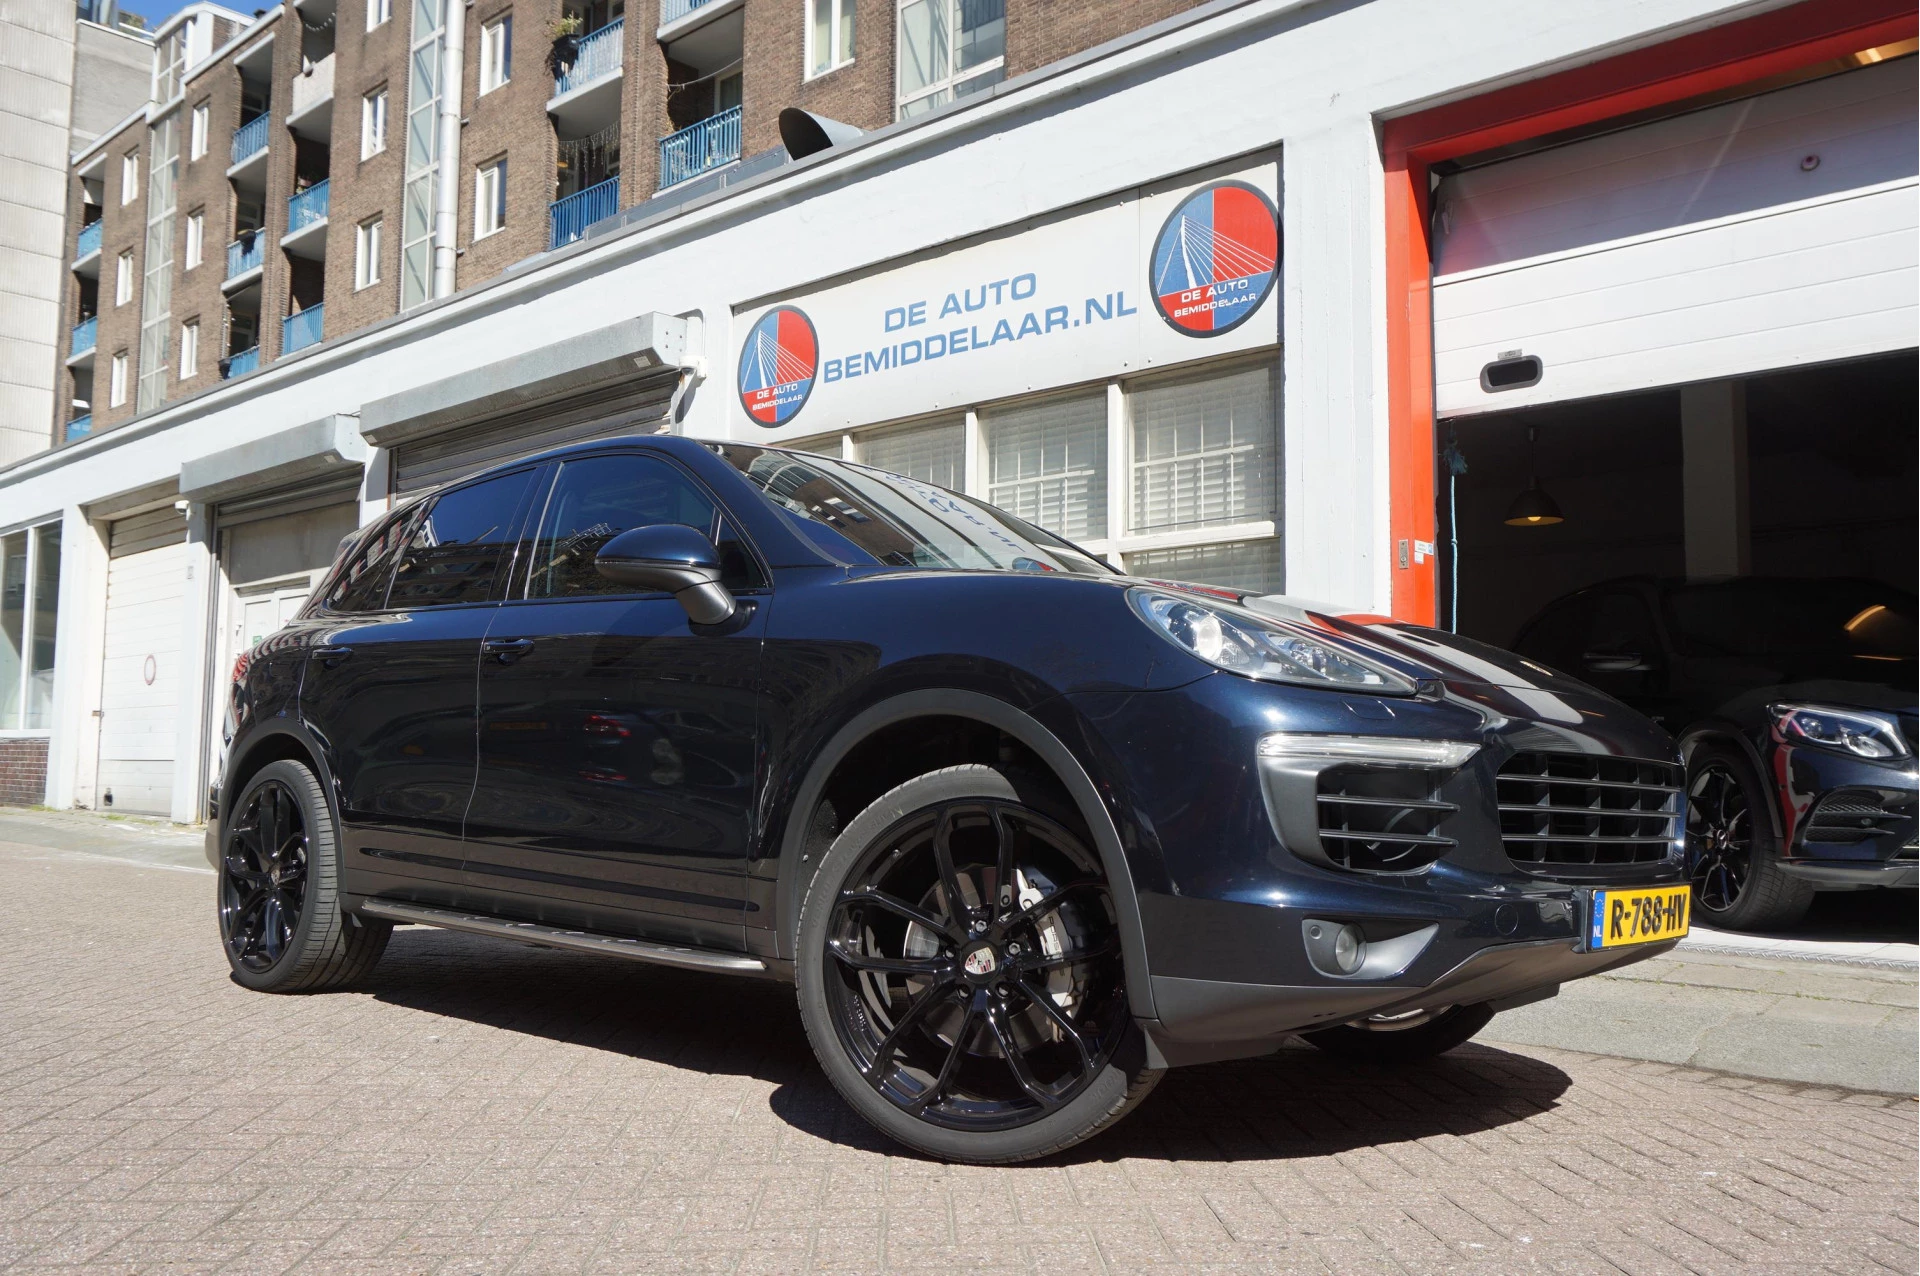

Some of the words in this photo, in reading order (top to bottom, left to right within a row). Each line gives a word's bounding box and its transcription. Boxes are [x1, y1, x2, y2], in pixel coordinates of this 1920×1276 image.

[885, 300, 927, 333] DE
[938, 272, 1037, 320] AUTO
[1181, 289, 1202, 303] DE
[1206, 279, 1248, 297] AUTO
[1174, 293, 1256, 318] BEMIDDELAAR
[823, 291, 1137, 384] BEMIDDELAAR.NL
[752, 394, 803, 411] BEMIDDELAAR
[757, 389, 770, 400] DE
[772, 383, 798, 396] AUTO
[1610, 893, 1687, 940] R-788-HV
[1593, 925, 1602, 938] NL
